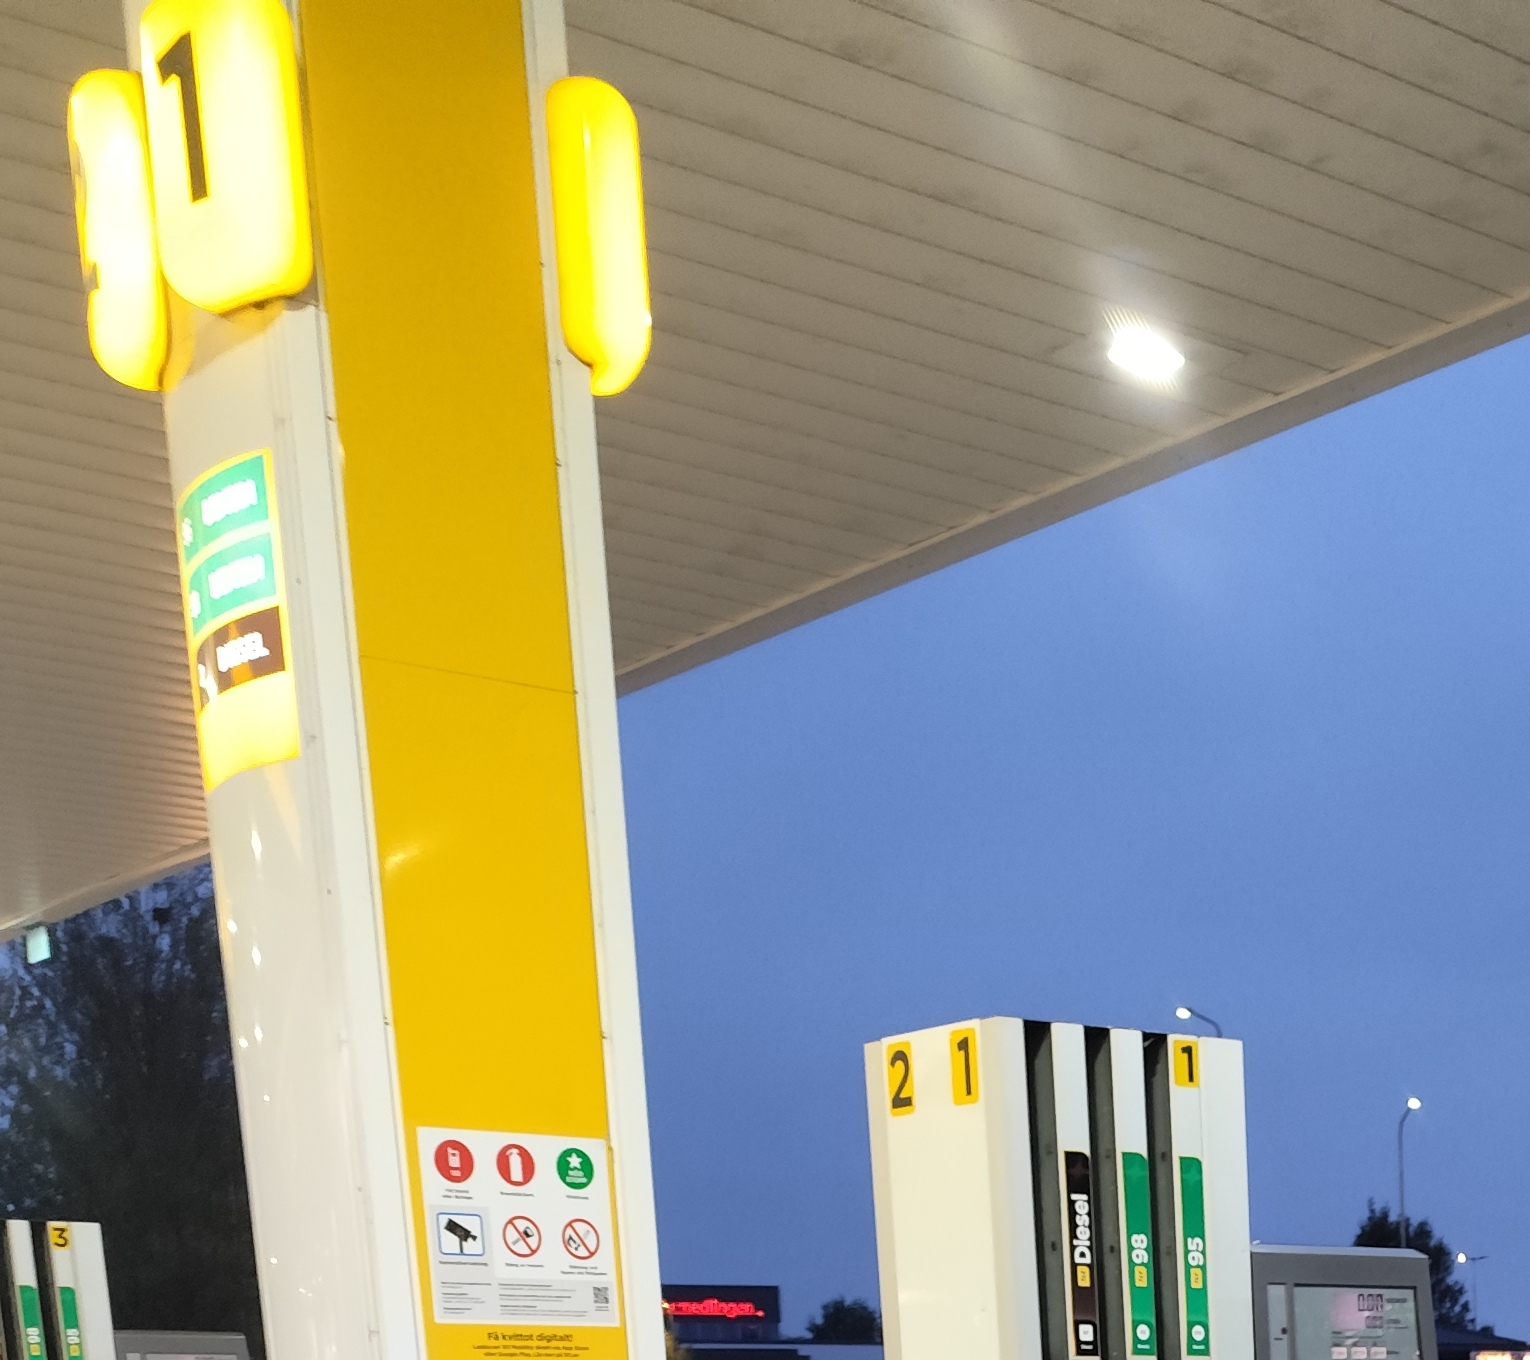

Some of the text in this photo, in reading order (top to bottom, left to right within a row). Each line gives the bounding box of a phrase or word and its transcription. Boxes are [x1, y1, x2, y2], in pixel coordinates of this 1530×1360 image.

[157, 31, 209, 203] 1
[889, 1036, 972, 1110] 2 1
[1181, 1045, 1195, 1083] 1
[52, 1227, 69, 1248] 3
[1070, 1193, 1092, 1265] Diesel
[1131, 1233, 1149, 1265] 98
[1187, 1236, 1204, 1267] 95
